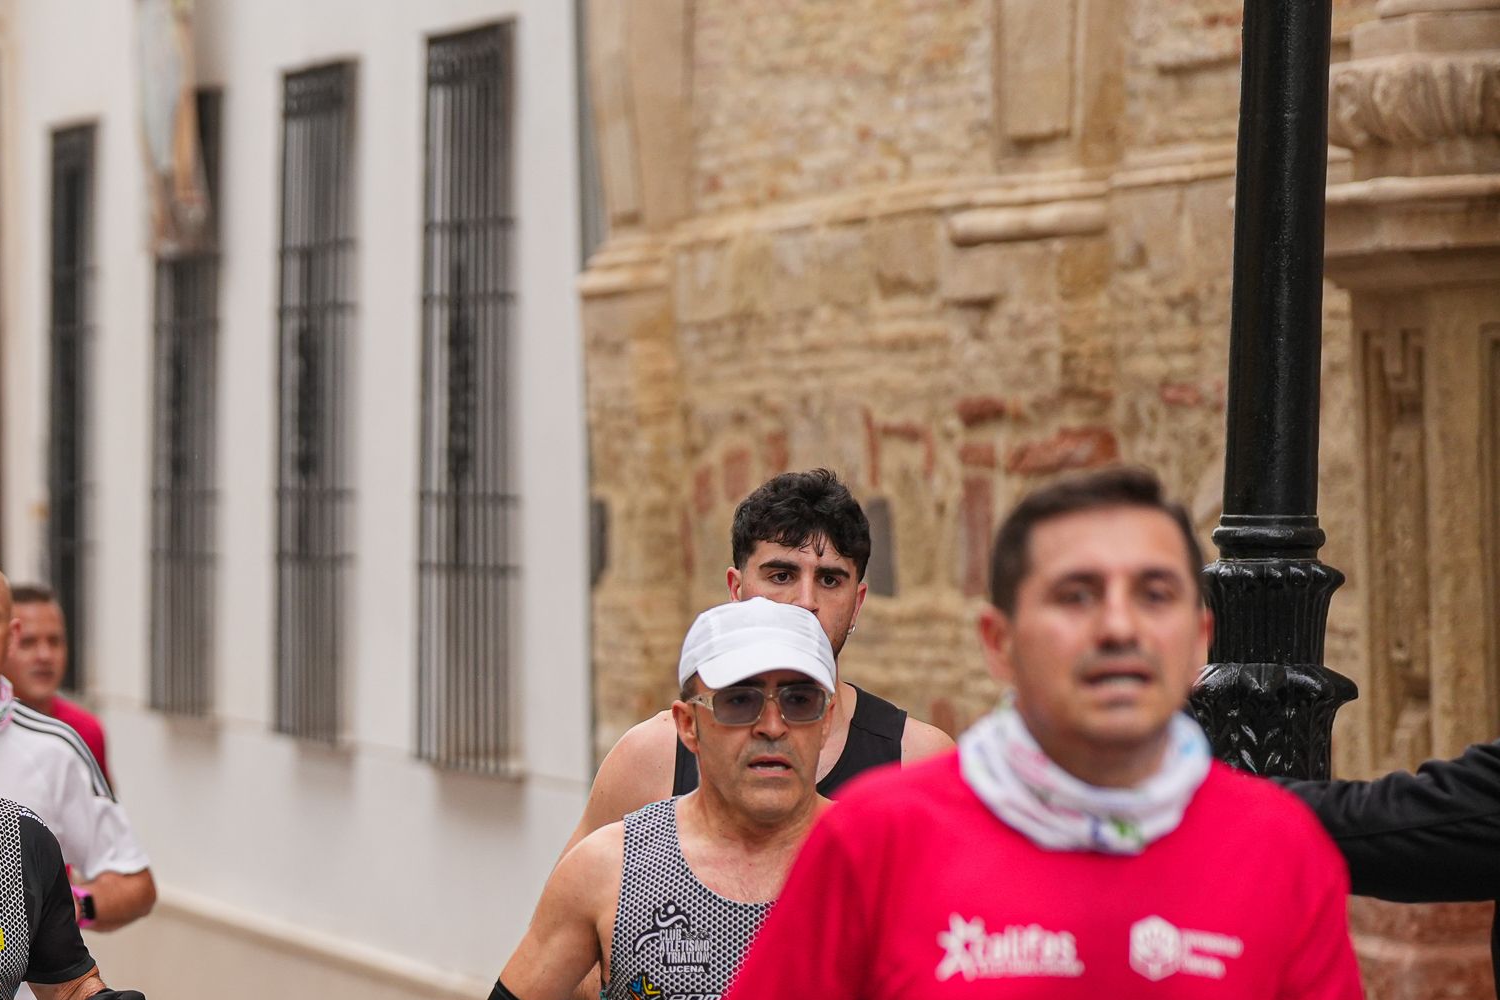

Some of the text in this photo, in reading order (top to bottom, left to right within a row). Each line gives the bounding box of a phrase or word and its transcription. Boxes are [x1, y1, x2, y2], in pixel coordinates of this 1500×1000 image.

[660, 929, 681, 940] CLUB
[660, 940, 710, 952] ATLETISMO
[663, 965, 705, 973] LUCENA
